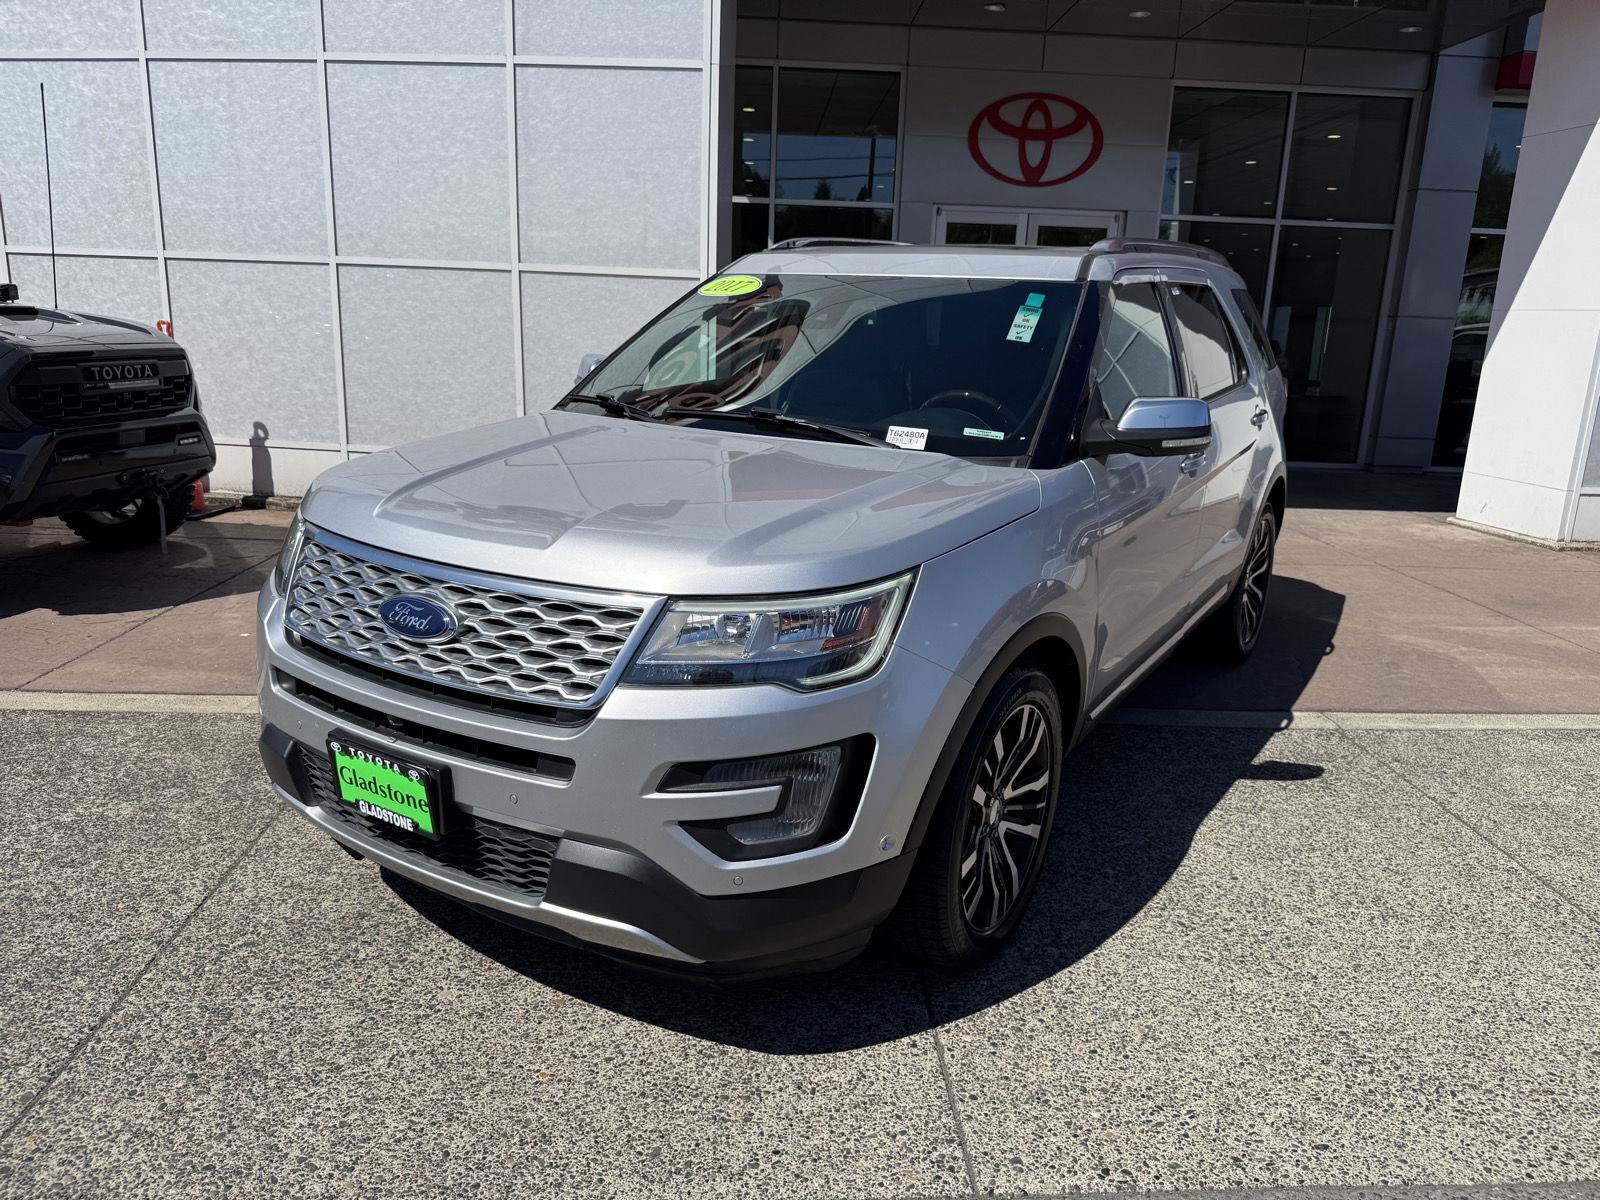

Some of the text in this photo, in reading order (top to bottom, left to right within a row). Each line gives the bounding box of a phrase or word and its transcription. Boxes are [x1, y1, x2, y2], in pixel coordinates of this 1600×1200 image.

[703, 280, 756, 292] 2017
[91, 364, 153, 380] TOYOTA
[889, 429, 926, 440] T62480A
[389, 602, 430, 632] Ford
[348, 747, 401, 773] TOYOTA
[339, 765, 429, 814] Gladstone
[358, 800, 415, 832] GLADSTONE
